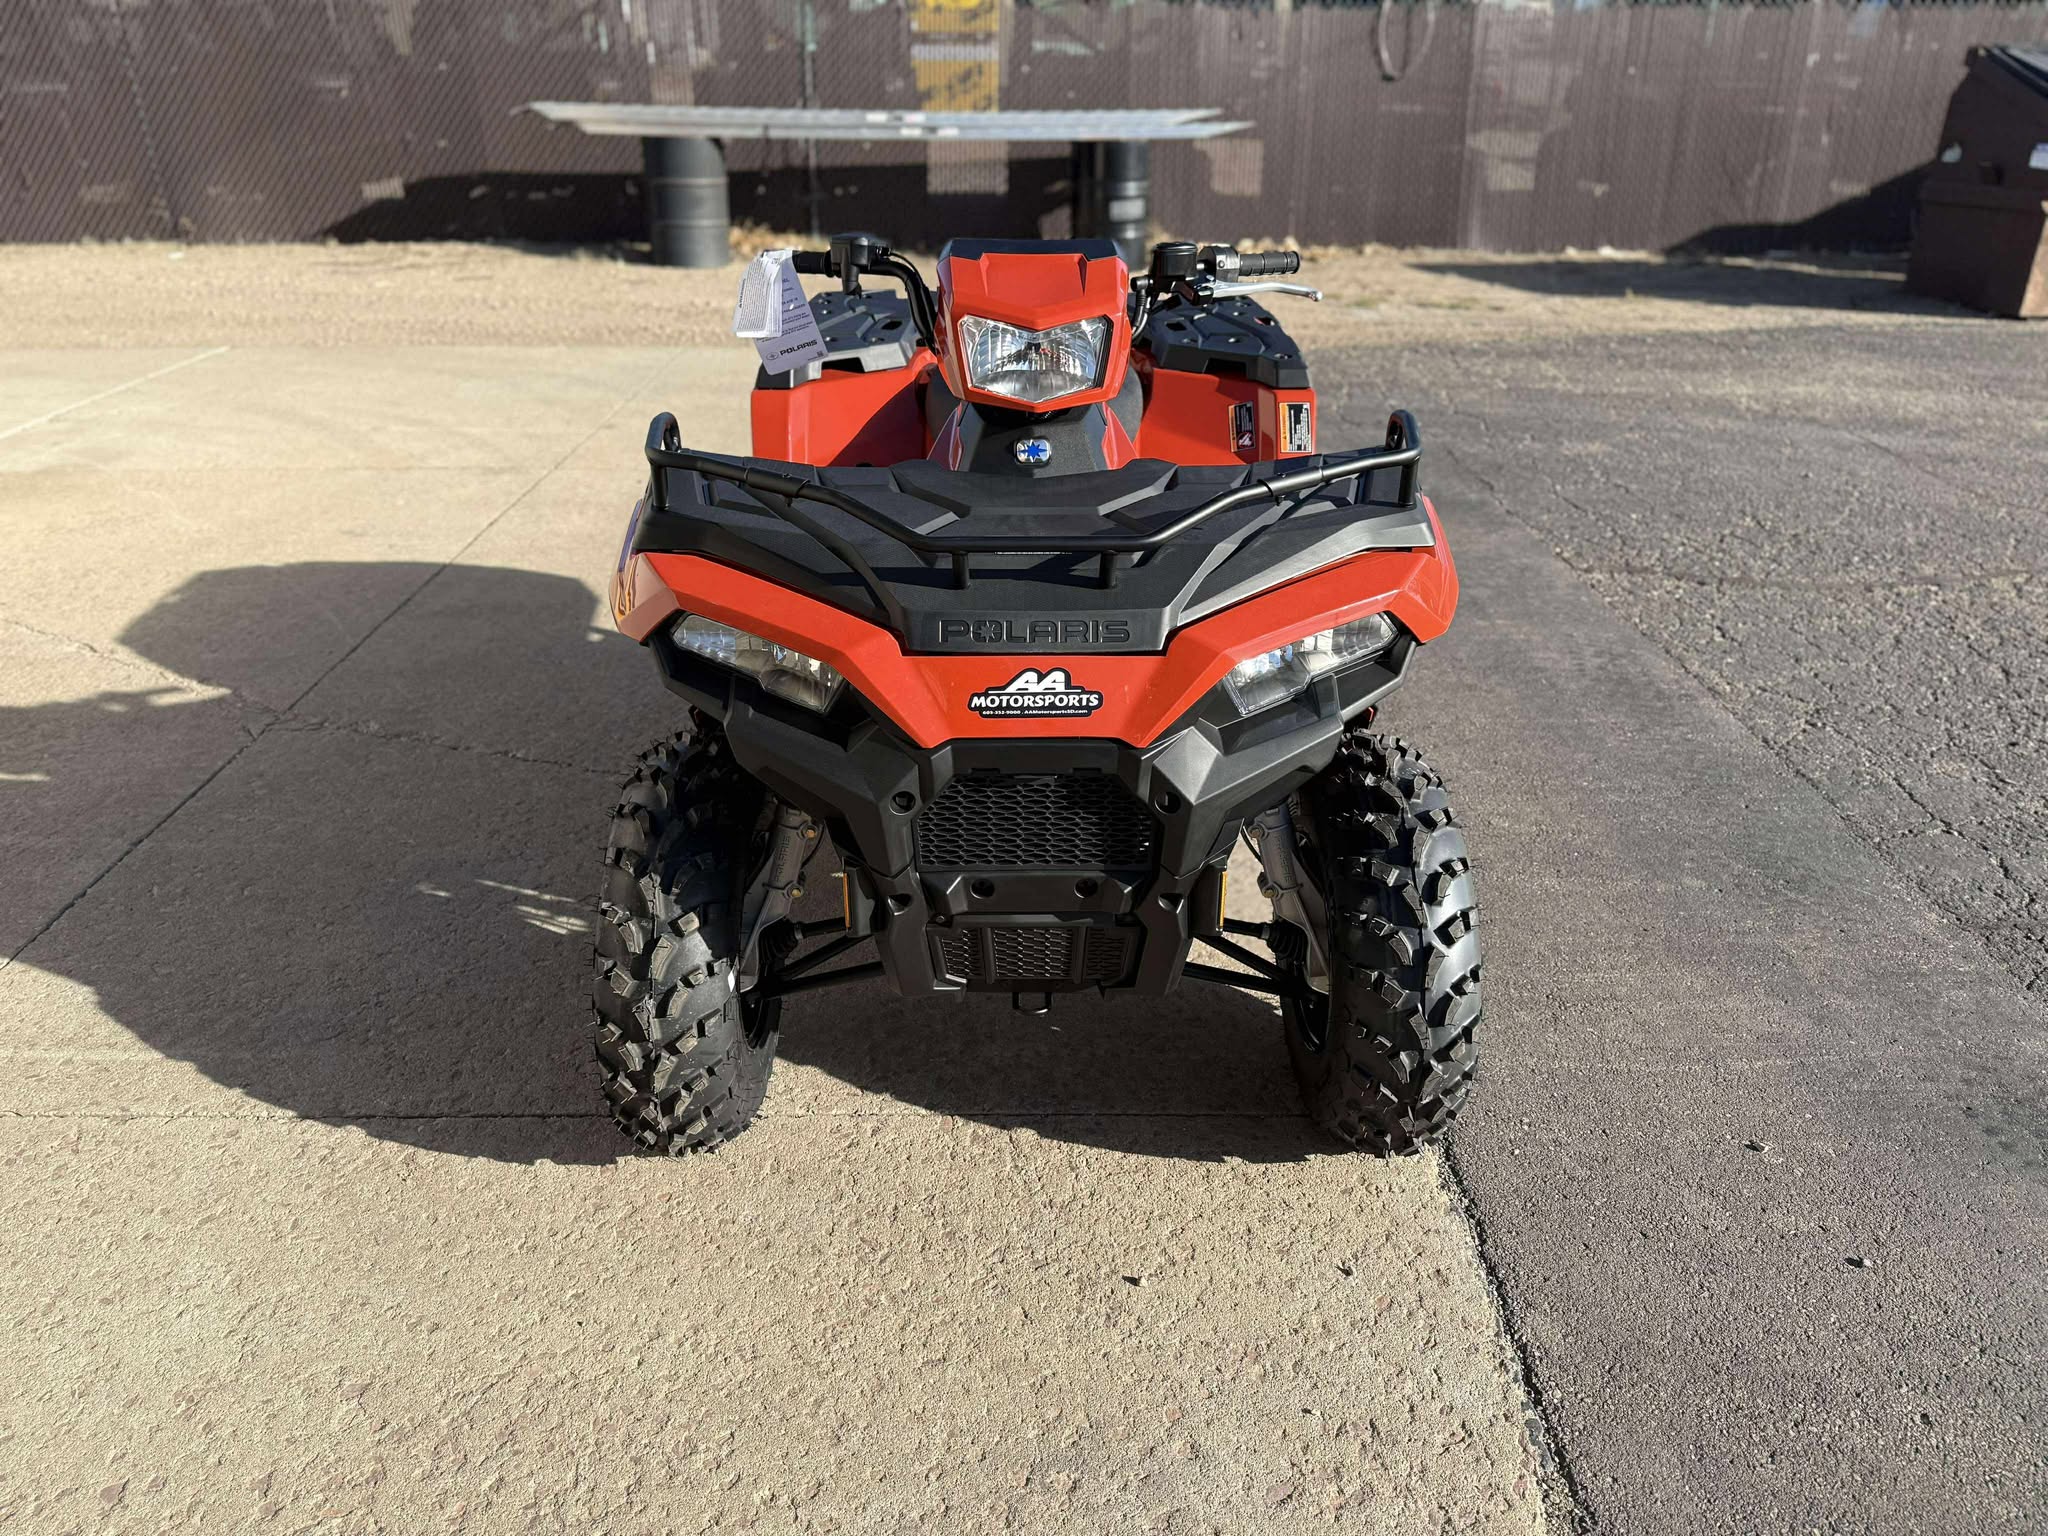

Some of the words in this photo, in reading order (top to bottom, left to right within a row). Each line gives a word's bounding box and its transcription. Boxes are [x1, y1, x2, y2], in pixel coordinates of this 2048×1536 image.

[780, 340, 818, 356] POLARIS
[939, 620, 1130, 643] POLARIS
[1003, 670, 1066, 692] AA
[971, 694, 1099, 708] MOTORSPORTS
